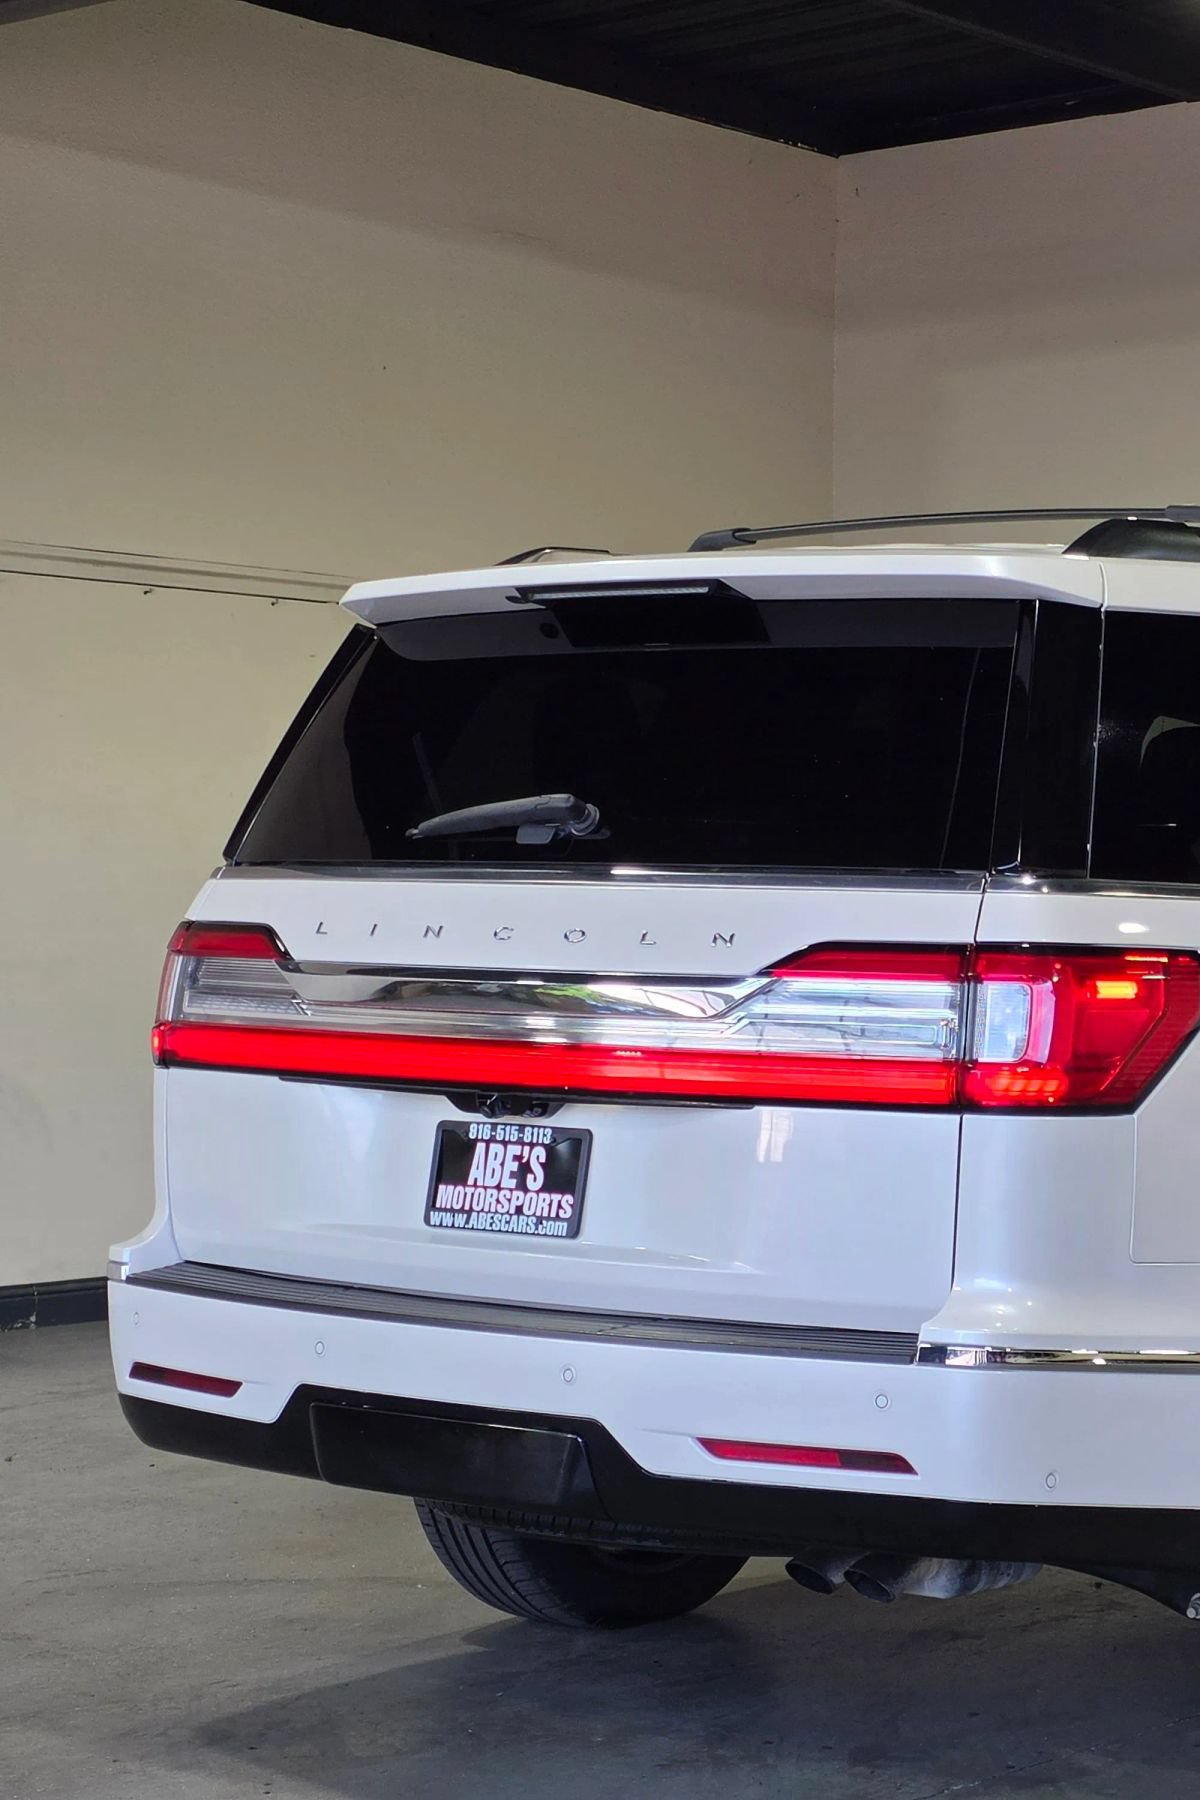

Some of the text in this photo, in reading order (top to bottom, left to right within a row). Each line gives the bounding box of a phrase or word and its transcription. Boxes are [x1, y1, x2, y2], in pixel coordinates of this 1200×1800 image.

[315, 921, 736, 948] LINCOLN
[467, 1142, 547, 1191] ABE'S
[435, 1184, 574, 1219] MOTORSPORTS
